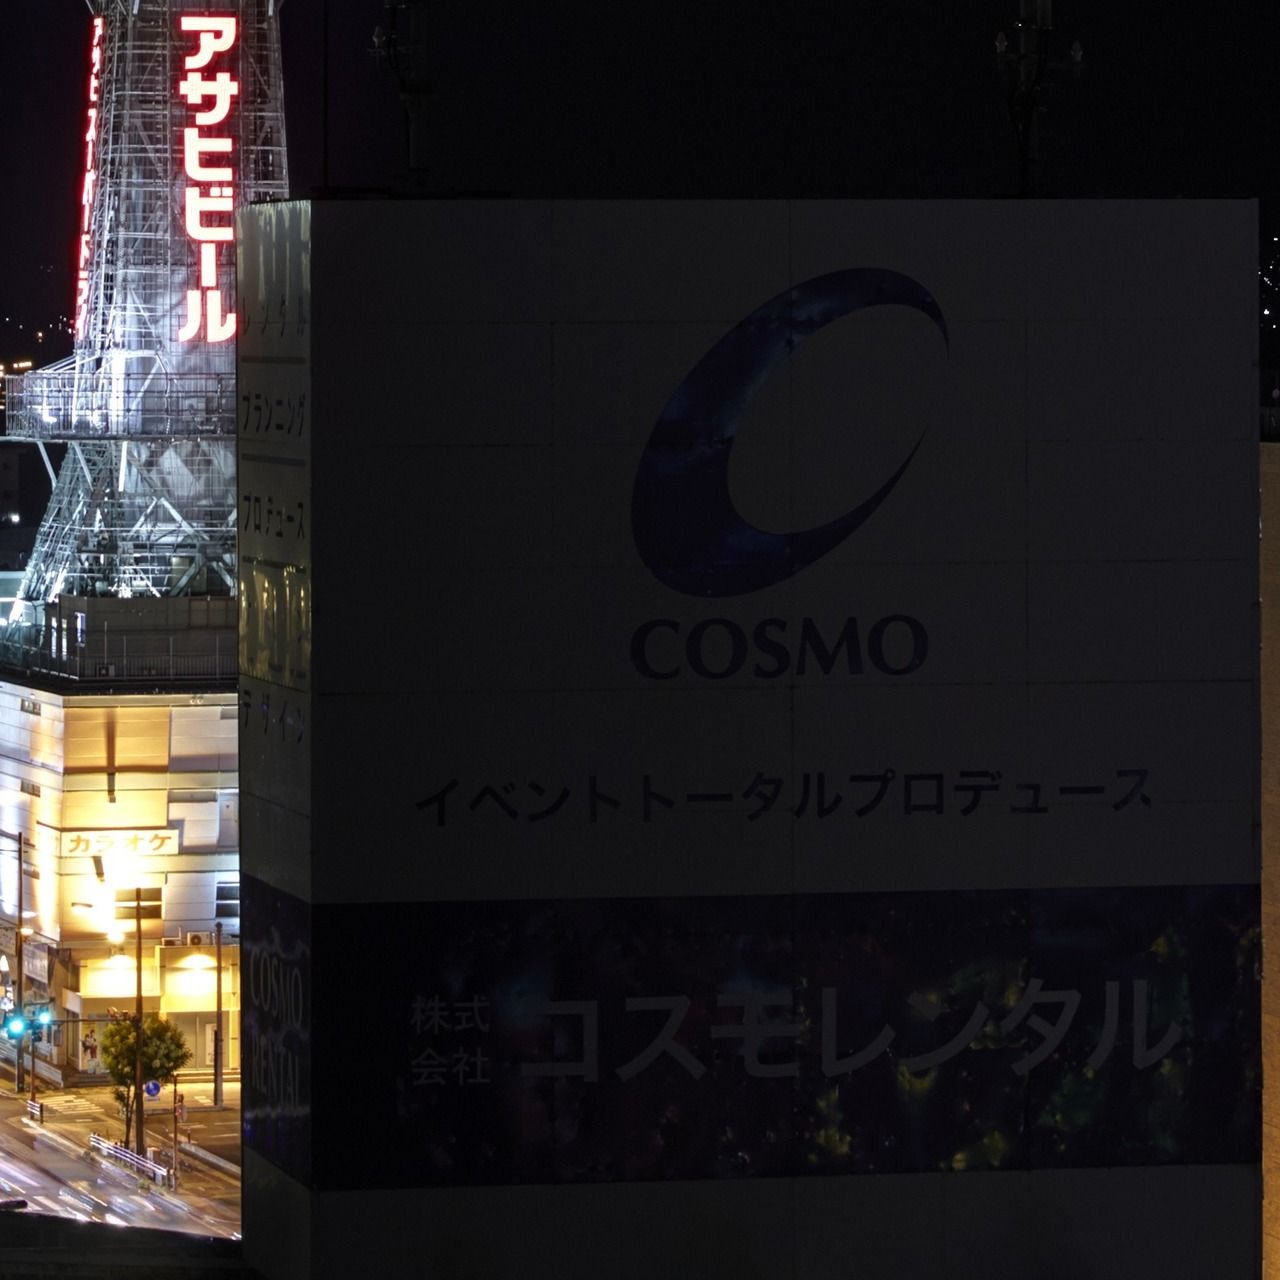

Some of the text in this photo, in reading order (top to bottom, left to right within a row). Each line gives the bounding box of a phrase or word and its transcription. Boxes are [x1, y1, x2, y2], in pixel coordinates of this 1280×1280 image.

[178, 16, 238, 342] アサヒビール
[629, 613, 930, 680] COSMO
[415, 768, 1152, 826] イベントトータルプロデュース
[67, 833, 172, 853] カラオケ
[250, 944, 304, 1029] COSMO
[410, 994, 492, 1035] 株式
[520, 977, 1183, 1083] コスモレンタル
[250, 1030, 301, 1105] RENTAL
[410, 1046, 492, 1088] 会社
